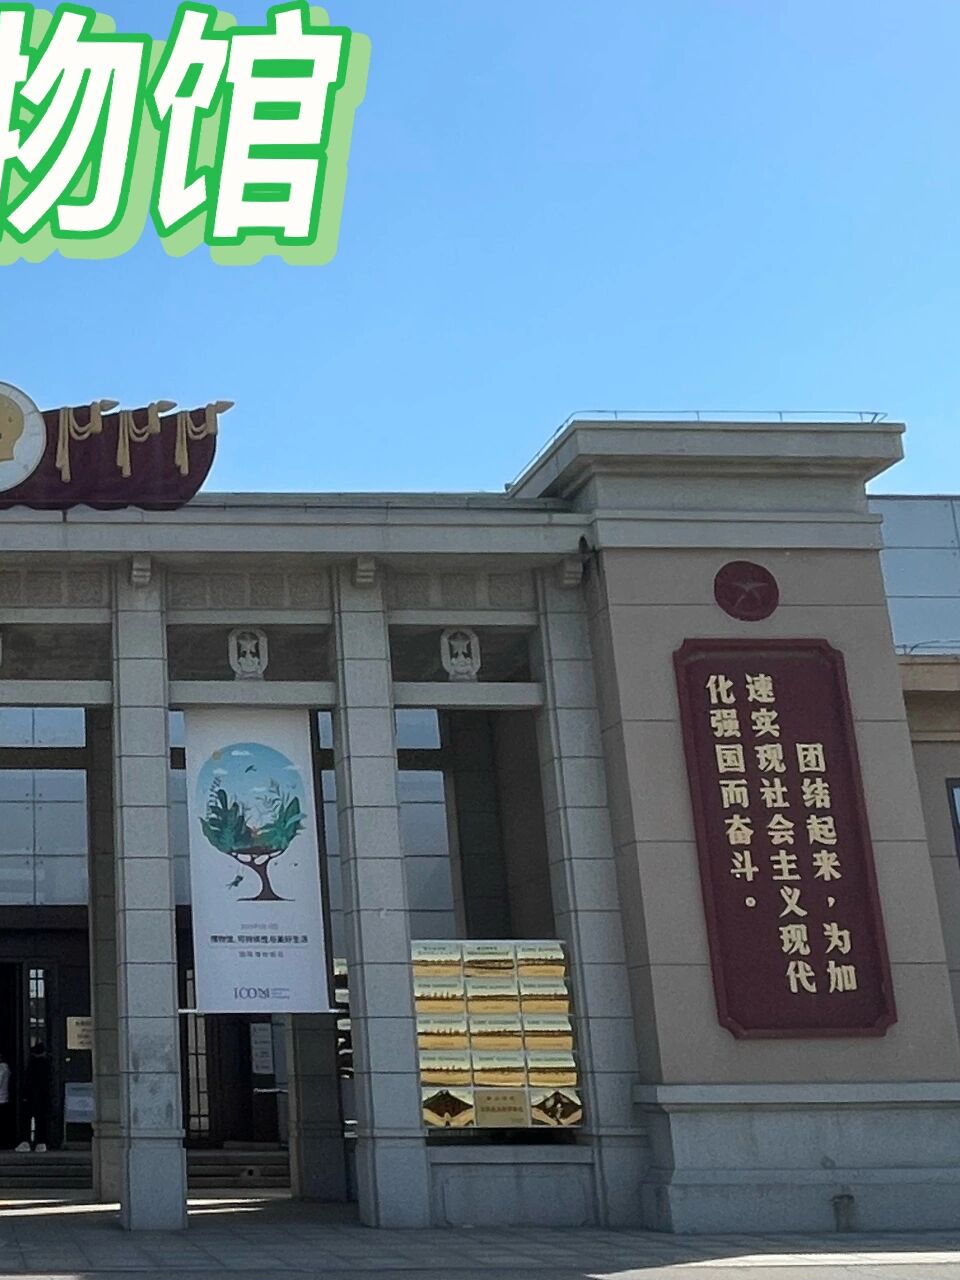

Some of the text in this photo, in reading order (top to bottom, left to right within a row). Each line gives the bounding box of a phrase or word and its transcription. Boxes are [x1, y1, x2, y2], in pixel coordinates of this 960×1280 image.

[705, 674, 760, 909] 化强国而奋斗。
[746, 673, 817, 994] 速实现社会主义现代
